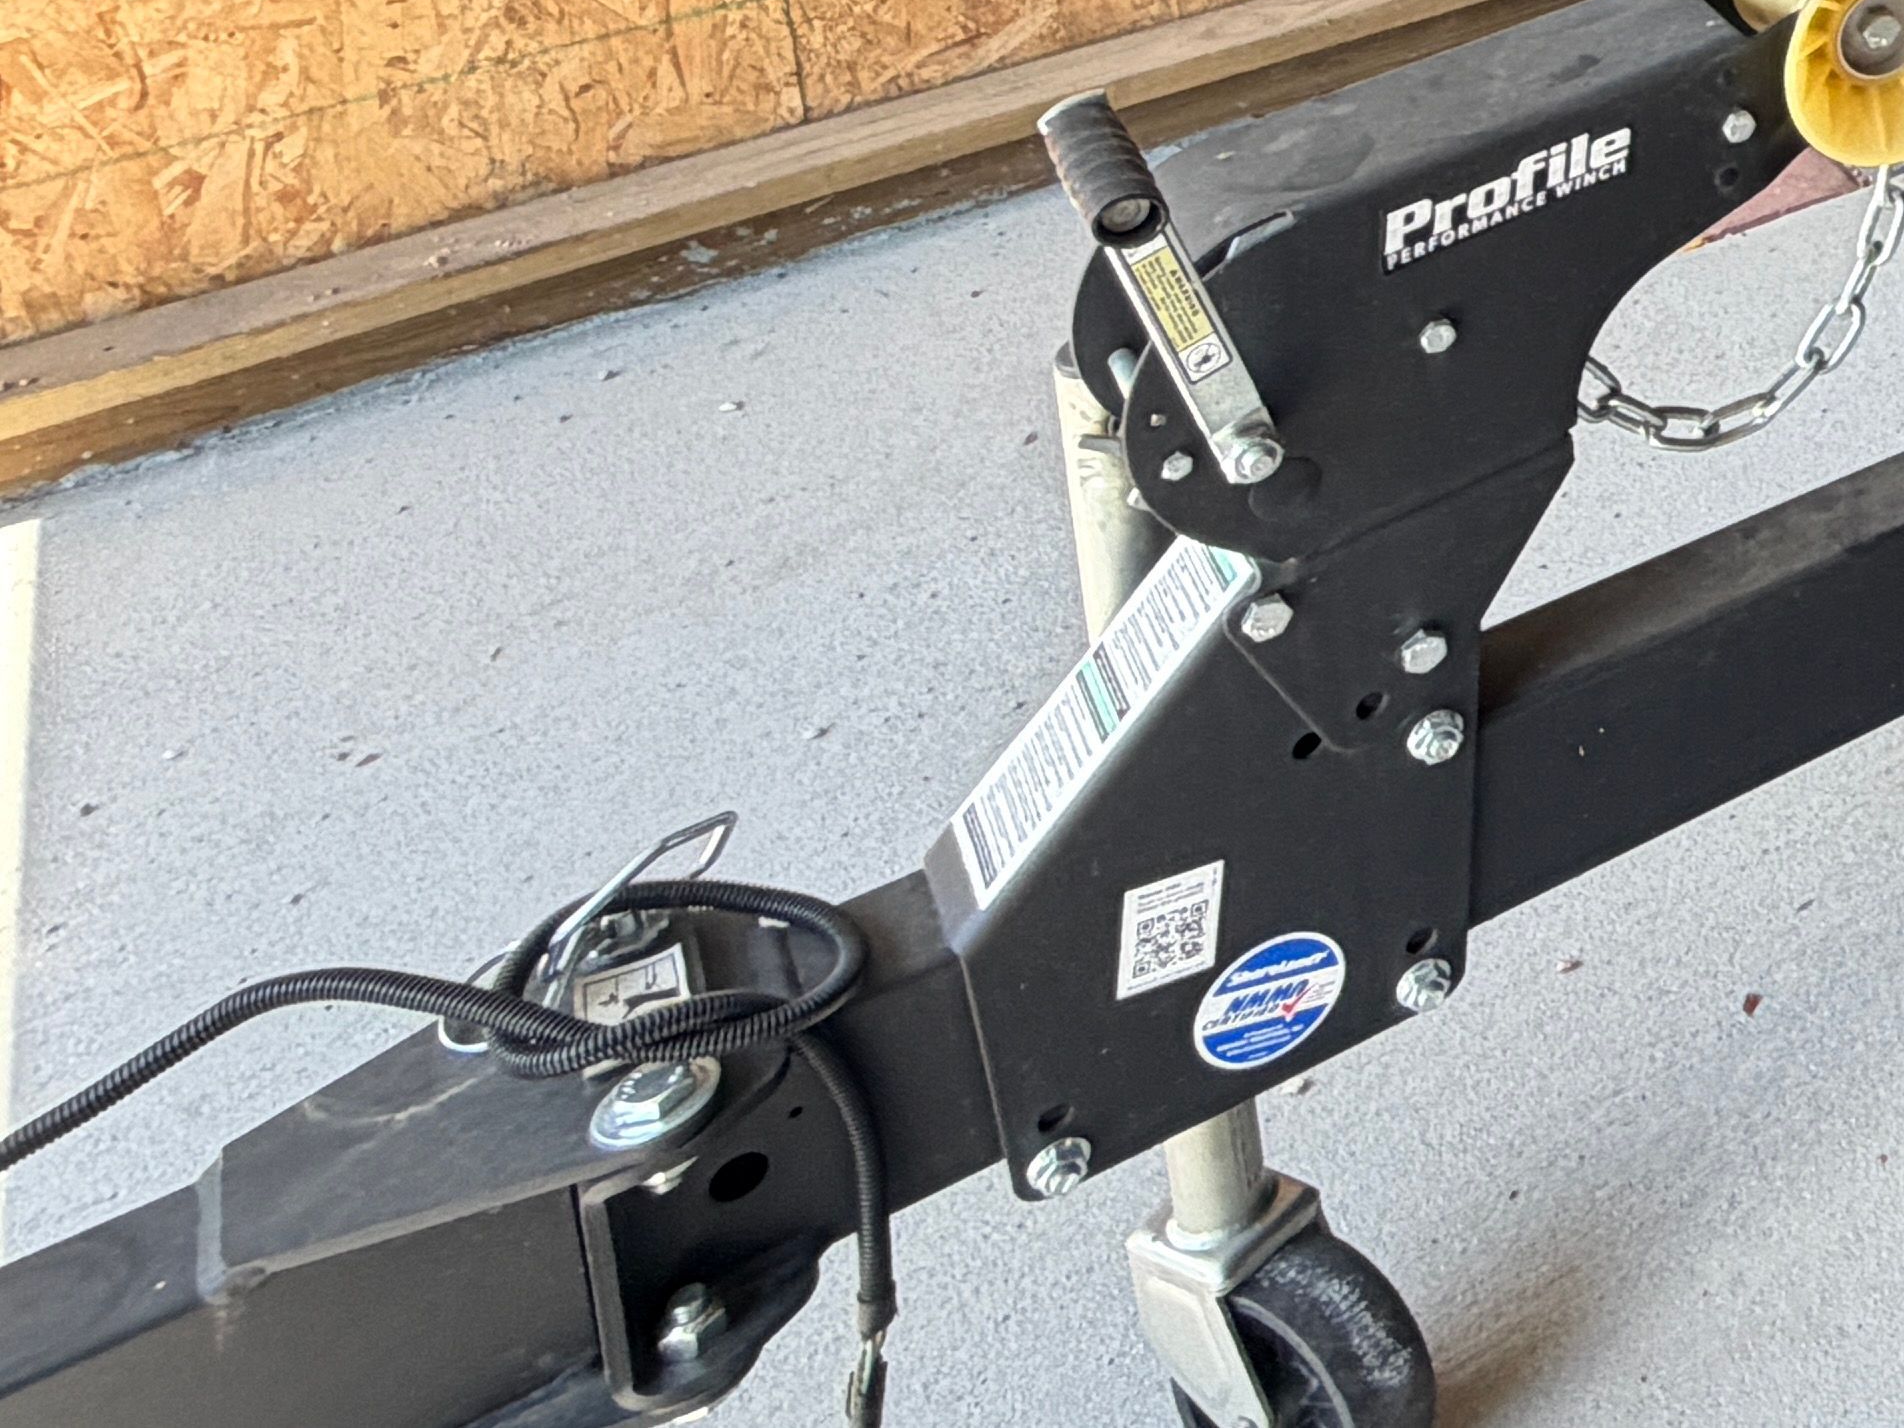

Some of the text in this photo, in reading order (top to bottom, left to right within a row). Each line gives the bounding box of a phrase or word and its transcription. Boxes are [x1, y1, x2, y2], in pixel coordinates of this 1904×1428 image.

[1384, 127, 1632, 256] Profile
[1386, 158, 1627, 271] PERFORMANCE WINCH
